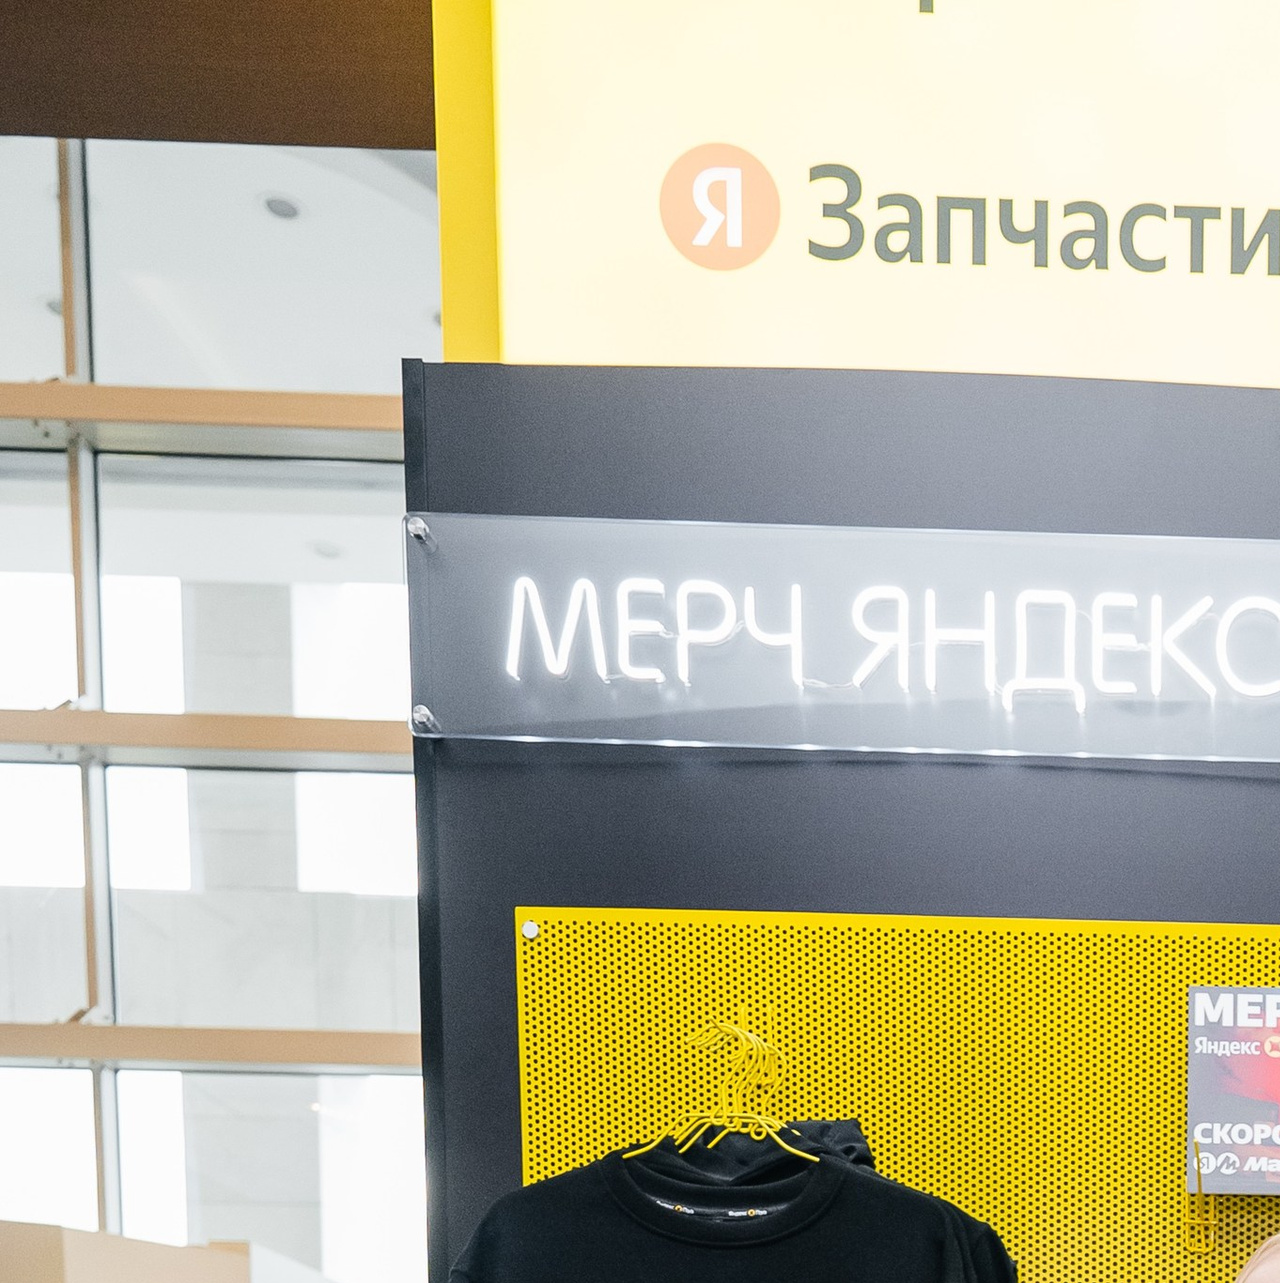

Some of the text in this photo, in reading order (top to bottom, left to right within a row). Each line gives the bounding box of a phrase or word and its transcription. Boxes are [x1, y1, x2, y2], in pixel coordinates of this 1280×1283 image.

[691, 166, 743, 247] Я
[506, 577, 803, 687] МЕРЧ
[1194, 1036, 1261, 1058] Яндекс
